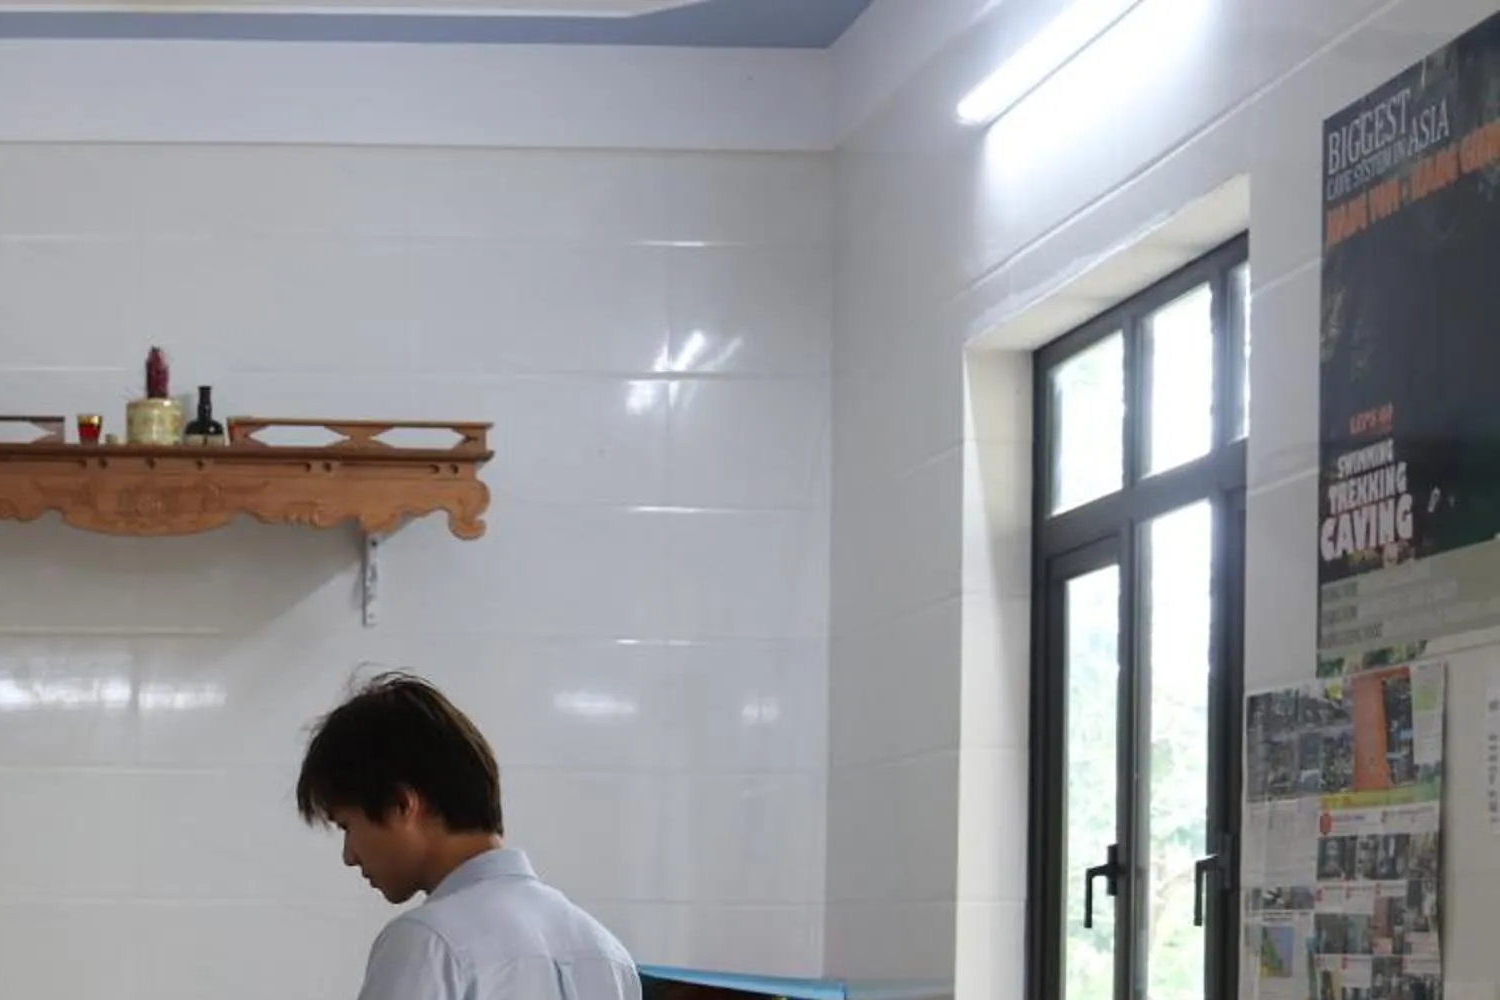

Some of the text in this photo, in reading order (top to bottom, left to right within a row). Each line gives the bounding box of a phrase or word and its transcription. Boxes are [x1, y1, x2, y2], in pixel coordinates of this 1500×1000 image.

[1328, 88, 1411, 175] BIGGEST
[1408, 97, 1450, 156] ASIA
[1329, 461, 1407, 515] TREKKING
[1321, 493, 1412, 561] CAVING
